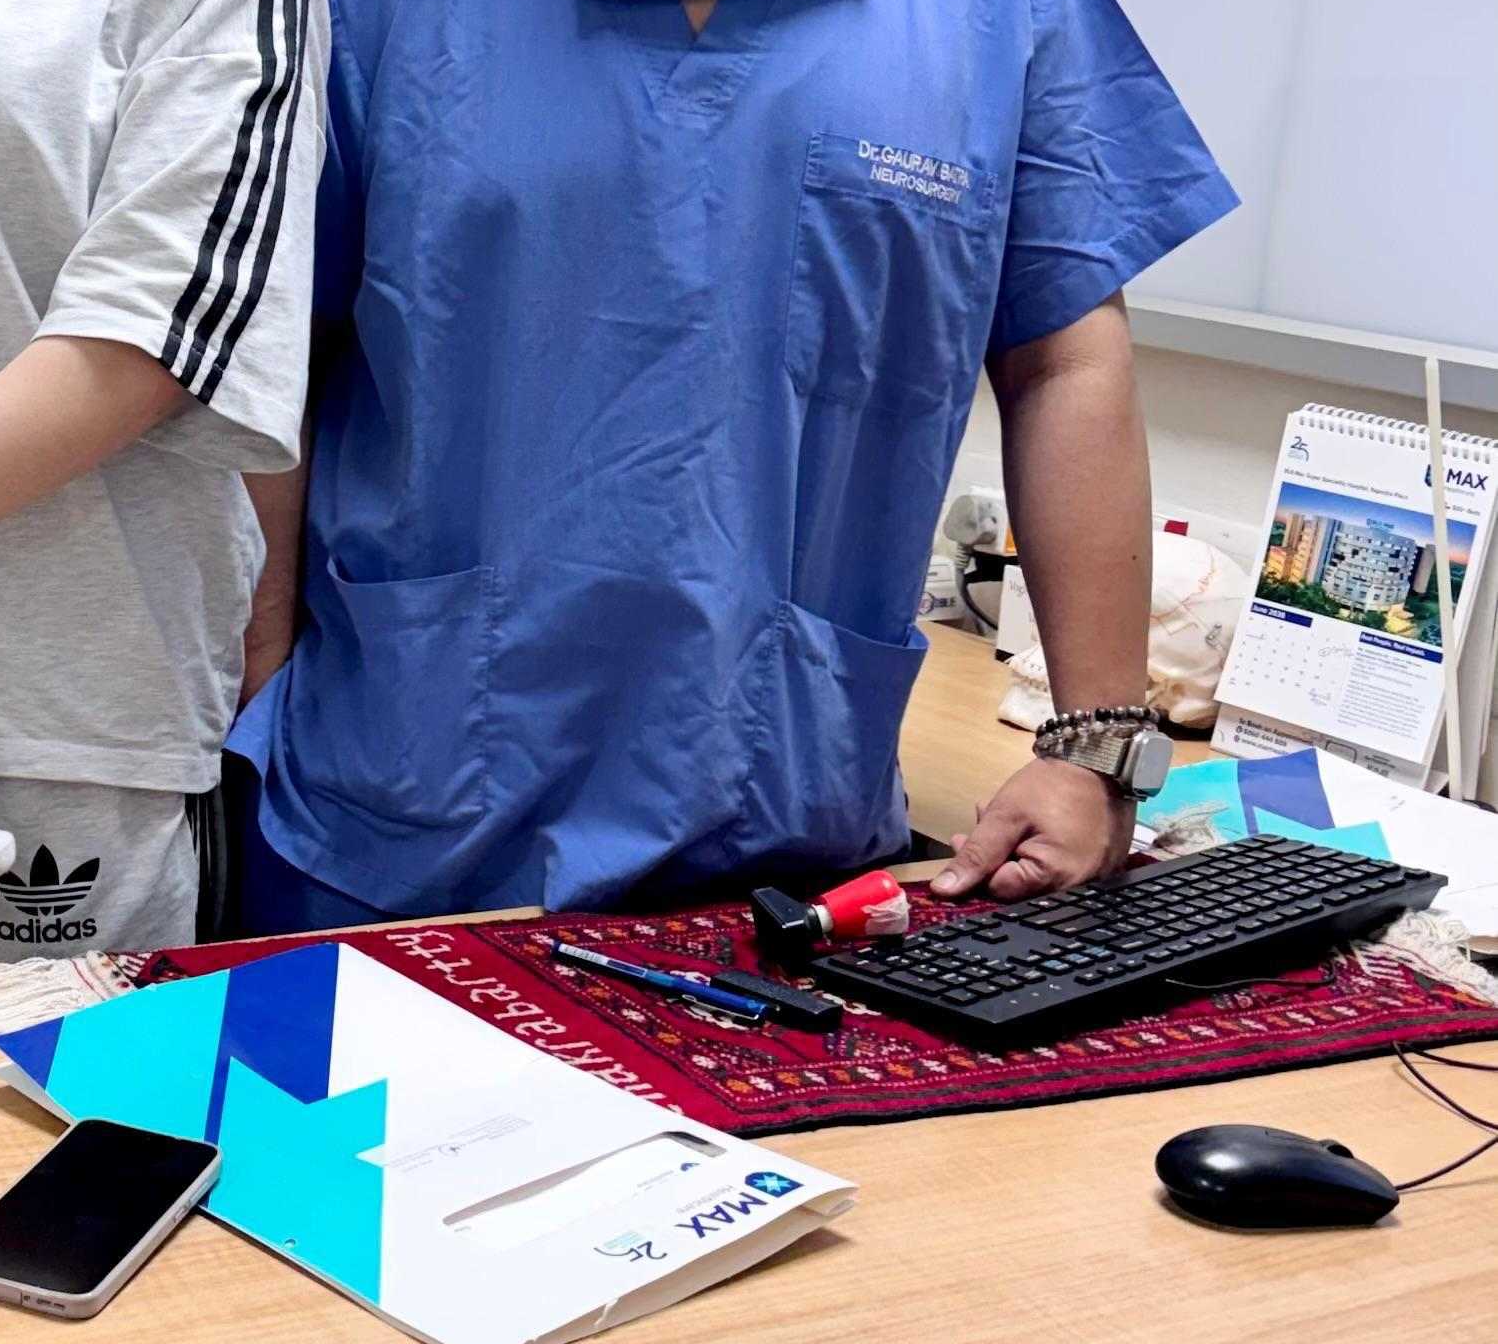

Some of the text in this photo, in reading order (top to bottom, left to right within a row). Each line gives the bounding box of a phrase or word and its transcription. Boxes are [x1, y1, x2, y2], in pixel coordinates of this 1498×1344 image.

[870, 163, 962, 205] NEUROSURGERY
[1446, 468, 1488, 491] MAX
[387, 929, 684, 1116] akrabartty
[674, 1191, 769, 1240] MAX
